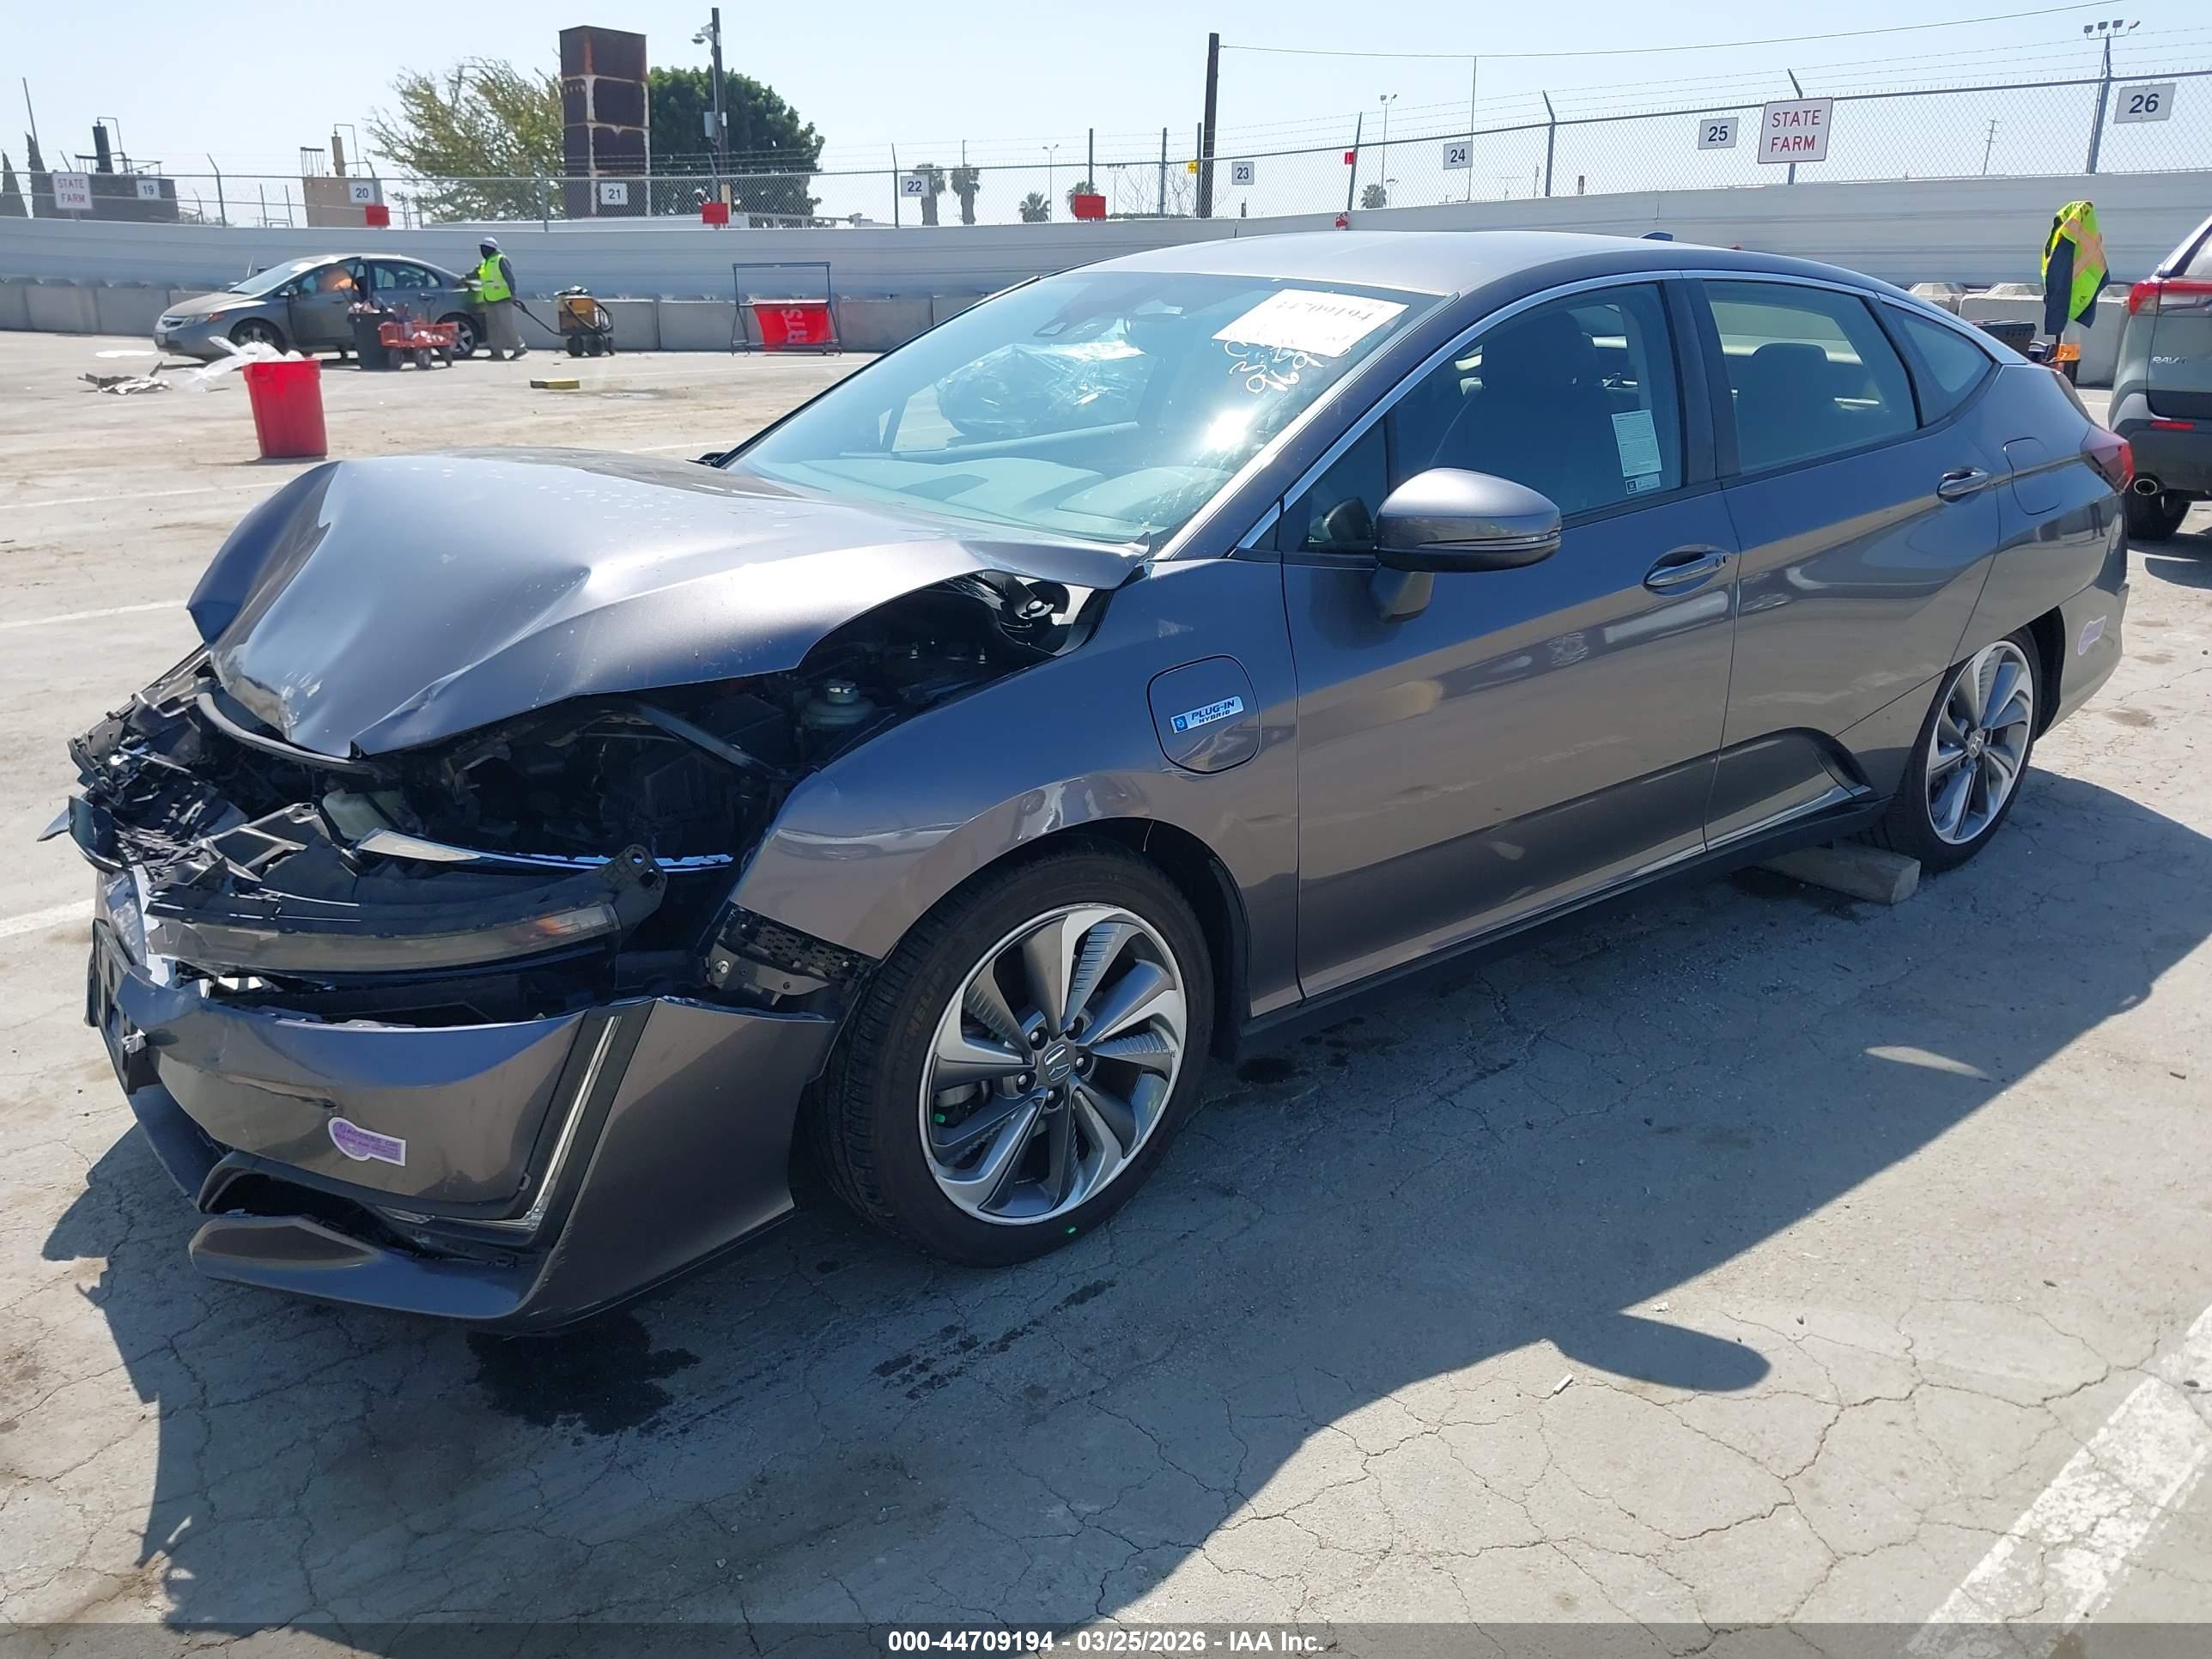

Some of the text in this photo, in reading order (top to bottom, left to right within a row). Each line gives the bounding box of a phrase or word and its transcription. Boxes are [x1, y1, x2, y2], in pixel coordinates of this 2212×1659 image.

[2129, 93, 2160, 114] 26
[1771, 109, 1822, 128] STATE
[1707, 125, 1729, 142] 25
[1770, 135, 1816, 153] FARM
[1449, 149, 1466, 163] 24
[1237, 167, 1249, 179] 23
[58, 178, 85, 189] STATE
[907, 180, 923, 192] 22
[143, 185, 155, 196] 19
[356, 187, 369, 198] 20
[608, 188, 621, 200] 21
[60, 192, 85, 204] FARM
[1191, 699, 1235, 720] PLUG-IN
[1199, 709, 1231, 724] HYBRID
